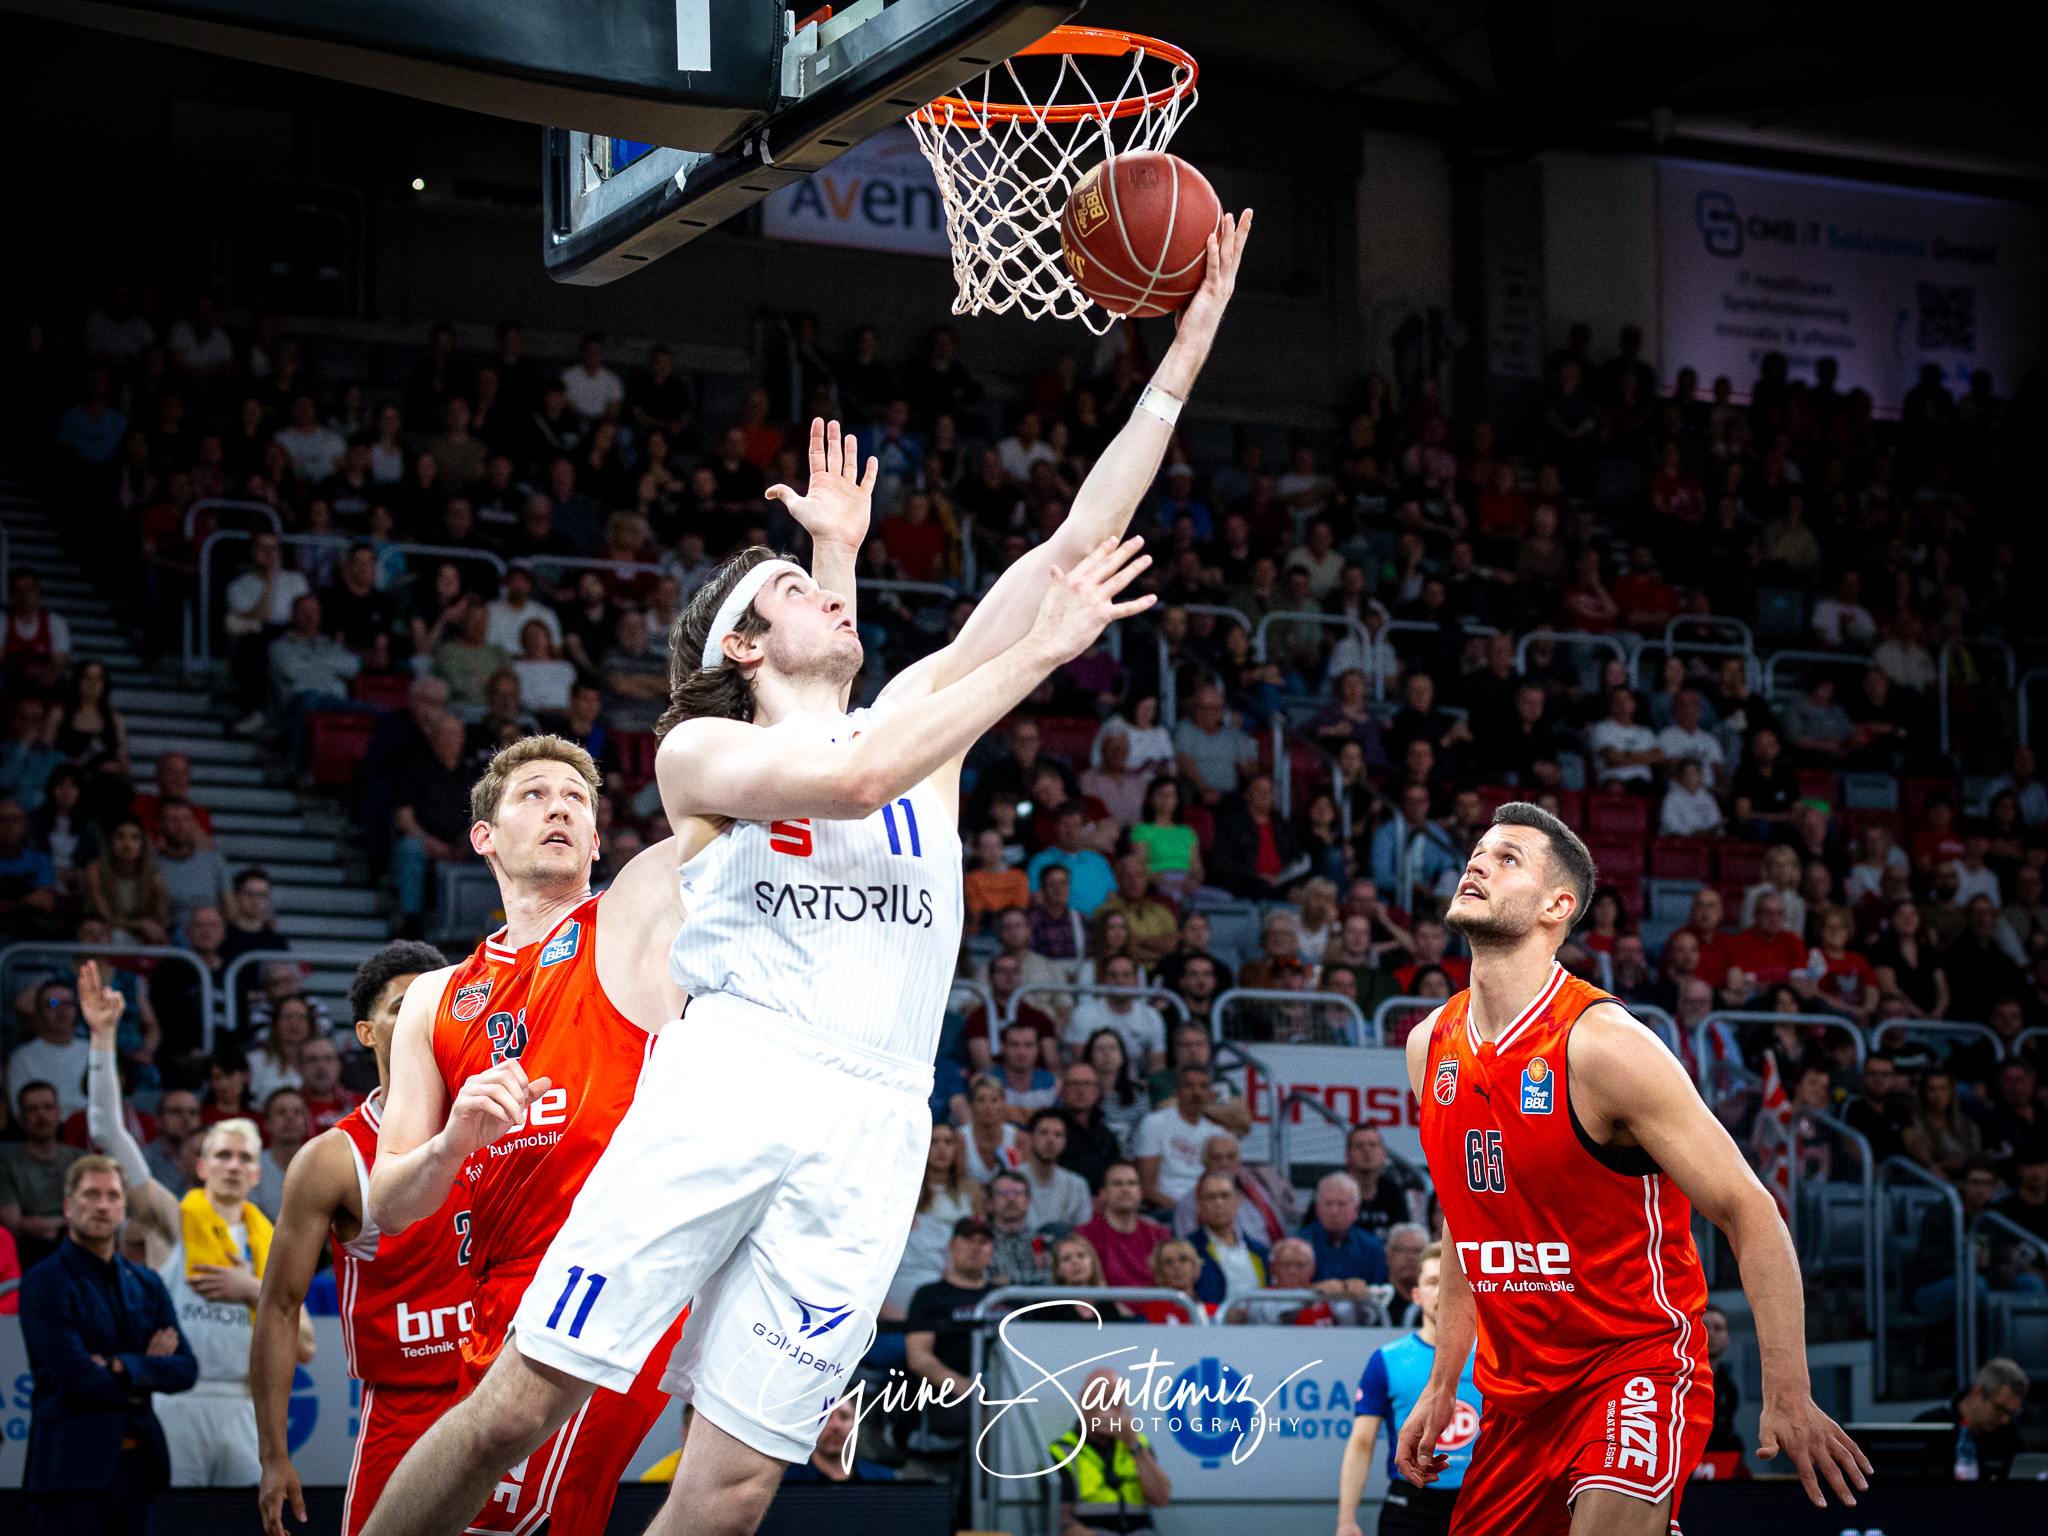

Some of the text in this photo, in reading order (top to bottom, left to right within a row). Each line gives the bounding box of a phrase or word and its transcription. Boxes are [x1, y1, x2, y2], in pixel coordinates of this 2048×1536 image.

[881, 798, 922, 858] 11
[754, 880, 933, 929] SARTORIUS
[545, 946, 571, 963] BBL
[1524, 1097, 1548, 1109] BBL
[1465, 1129, 1506, 1193] 65
[1455, 1241, 1571, 1275] rose
[546, 1265, 607, 1339] 11
[1477, 1280, 1499, 1293] für
[396, 1300, 475, 1343] bro
[401, 1341, 455, 1358] Technik
